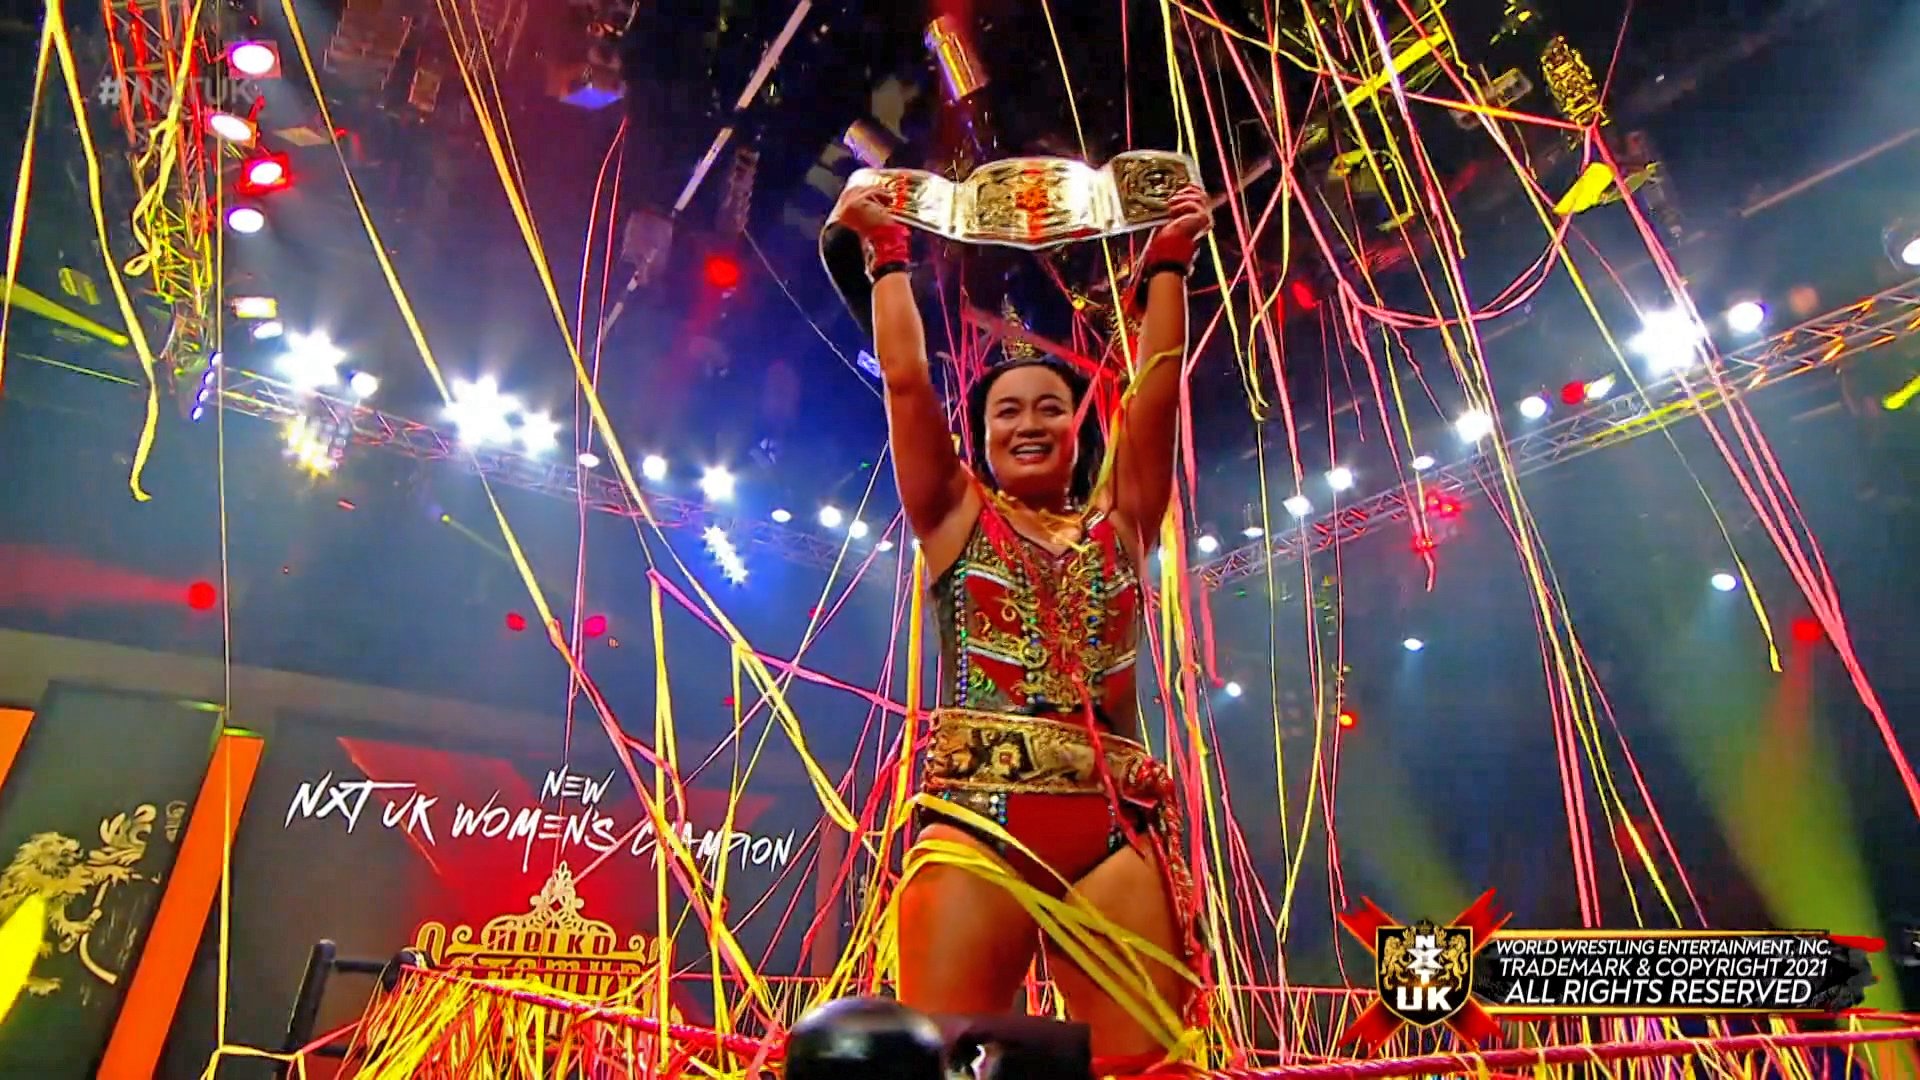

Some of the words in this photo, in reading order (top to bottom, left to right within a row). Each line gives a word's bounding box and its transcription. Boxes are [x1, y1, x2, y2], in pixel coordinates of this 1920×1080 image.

[541, 765, 615, 804] NEW
[284, 770, 417, 834] NXT
[382, 790, 439, 847] UK
[451, 789, 619, 873] WOMEN'S
